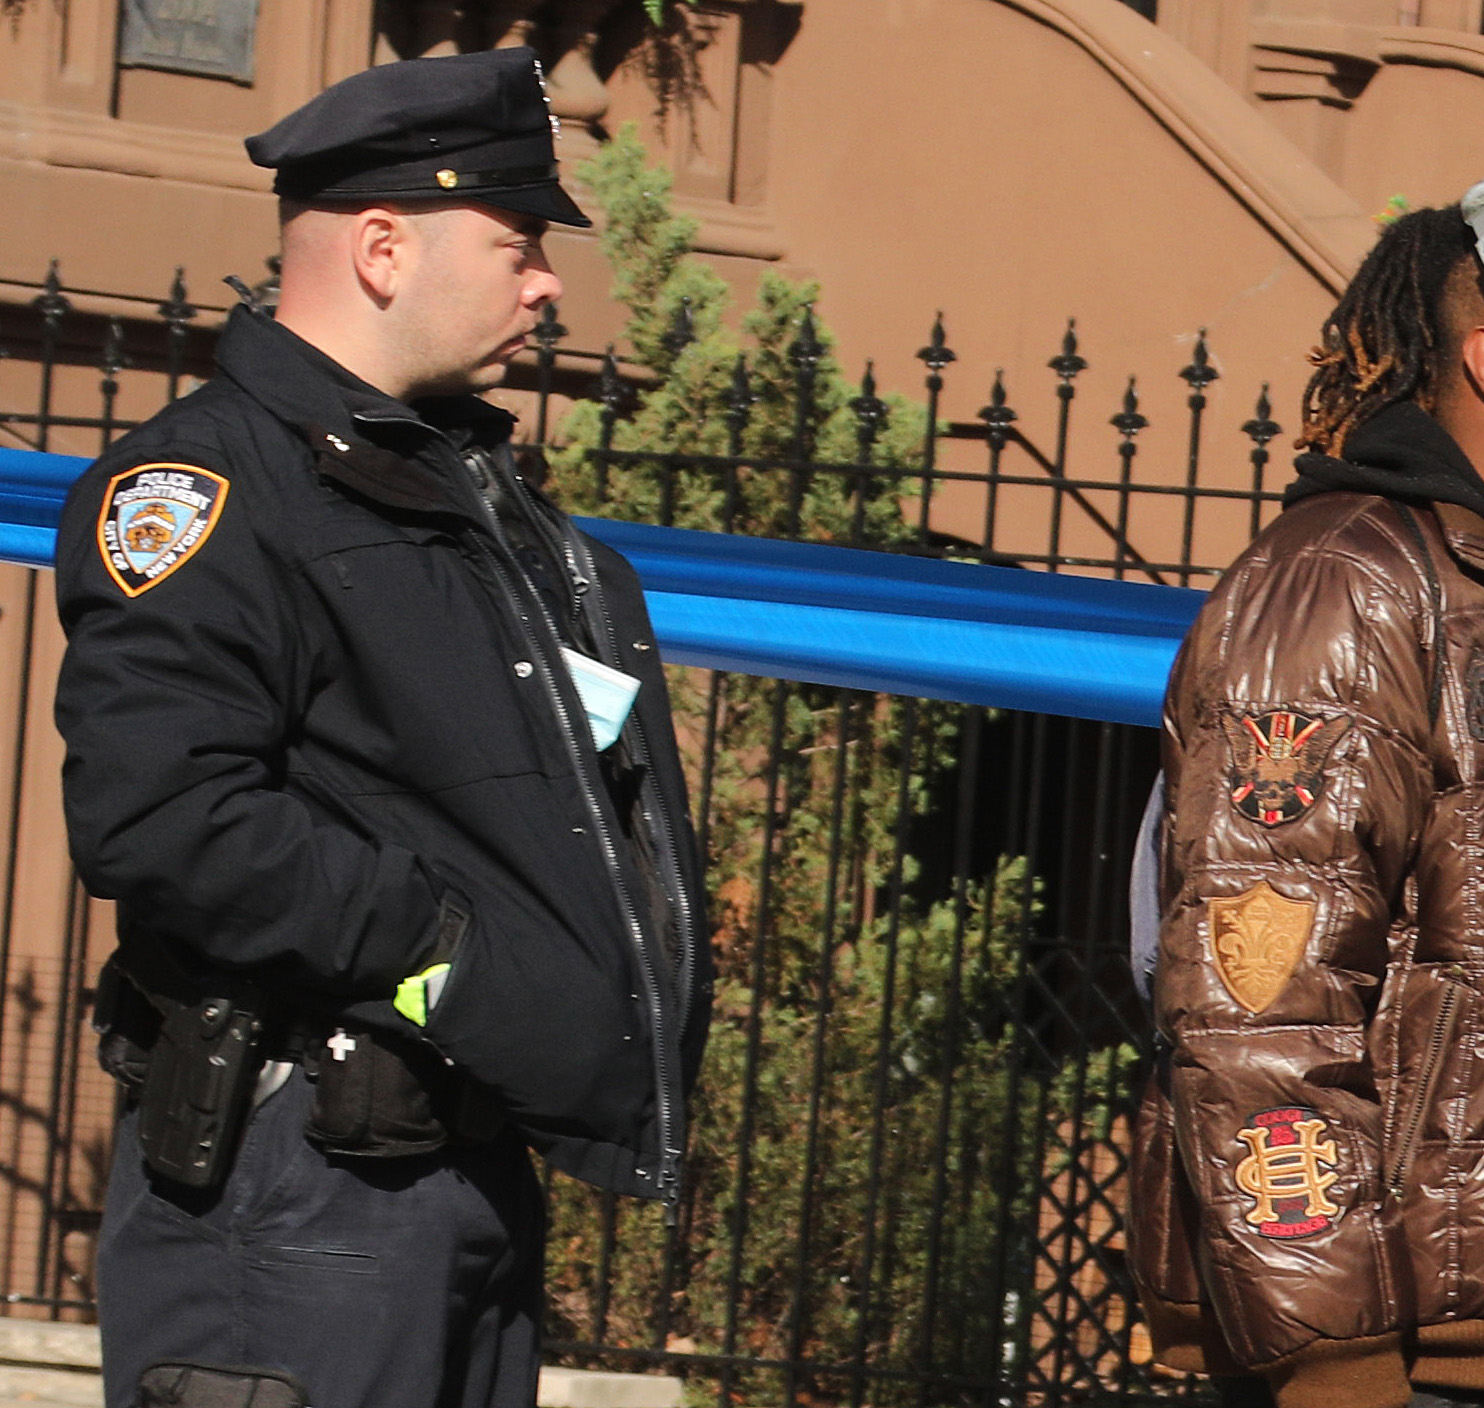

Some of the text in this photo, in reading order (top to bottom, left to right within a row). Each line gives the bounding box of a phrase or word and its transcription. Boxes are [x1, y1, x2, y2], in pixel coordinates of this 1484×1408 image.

[136, 472, 195, 490] POLICE
[112, 485, 212, 511] DEPARTMENT
[145, 518, 208, 579] NEW YORK
